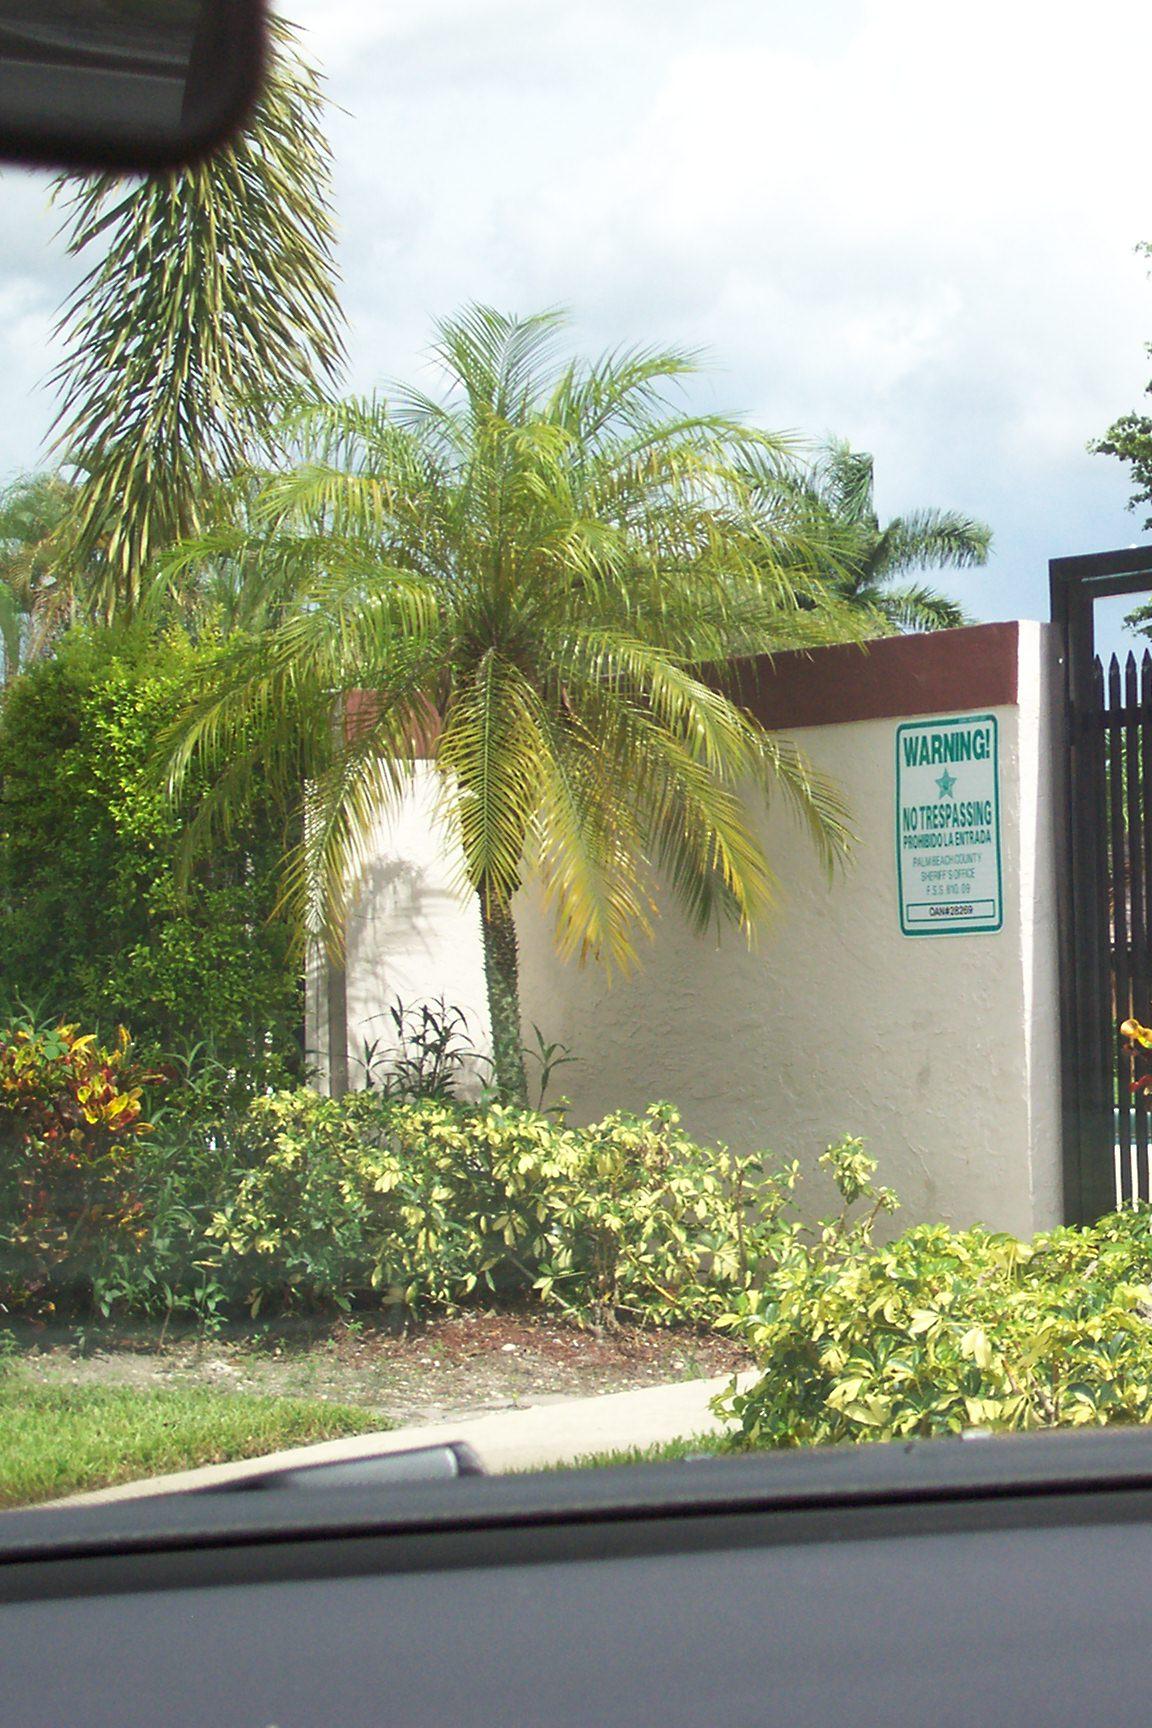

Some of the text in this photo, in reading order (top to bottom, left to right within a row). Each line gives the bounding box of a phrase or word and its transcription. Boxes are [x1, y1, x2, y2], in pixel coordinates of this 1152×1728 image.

[903, 728, 990, 767] WARNING!
[903, 800, 992, 831] NO TRESPASSING
[903, 829, 992, 849] PROHIBIDO LA ENTRADA
[912, 852, 983, 867] PALM BEACH COUNTY
[954, 867, 976, 880] OFFICE
